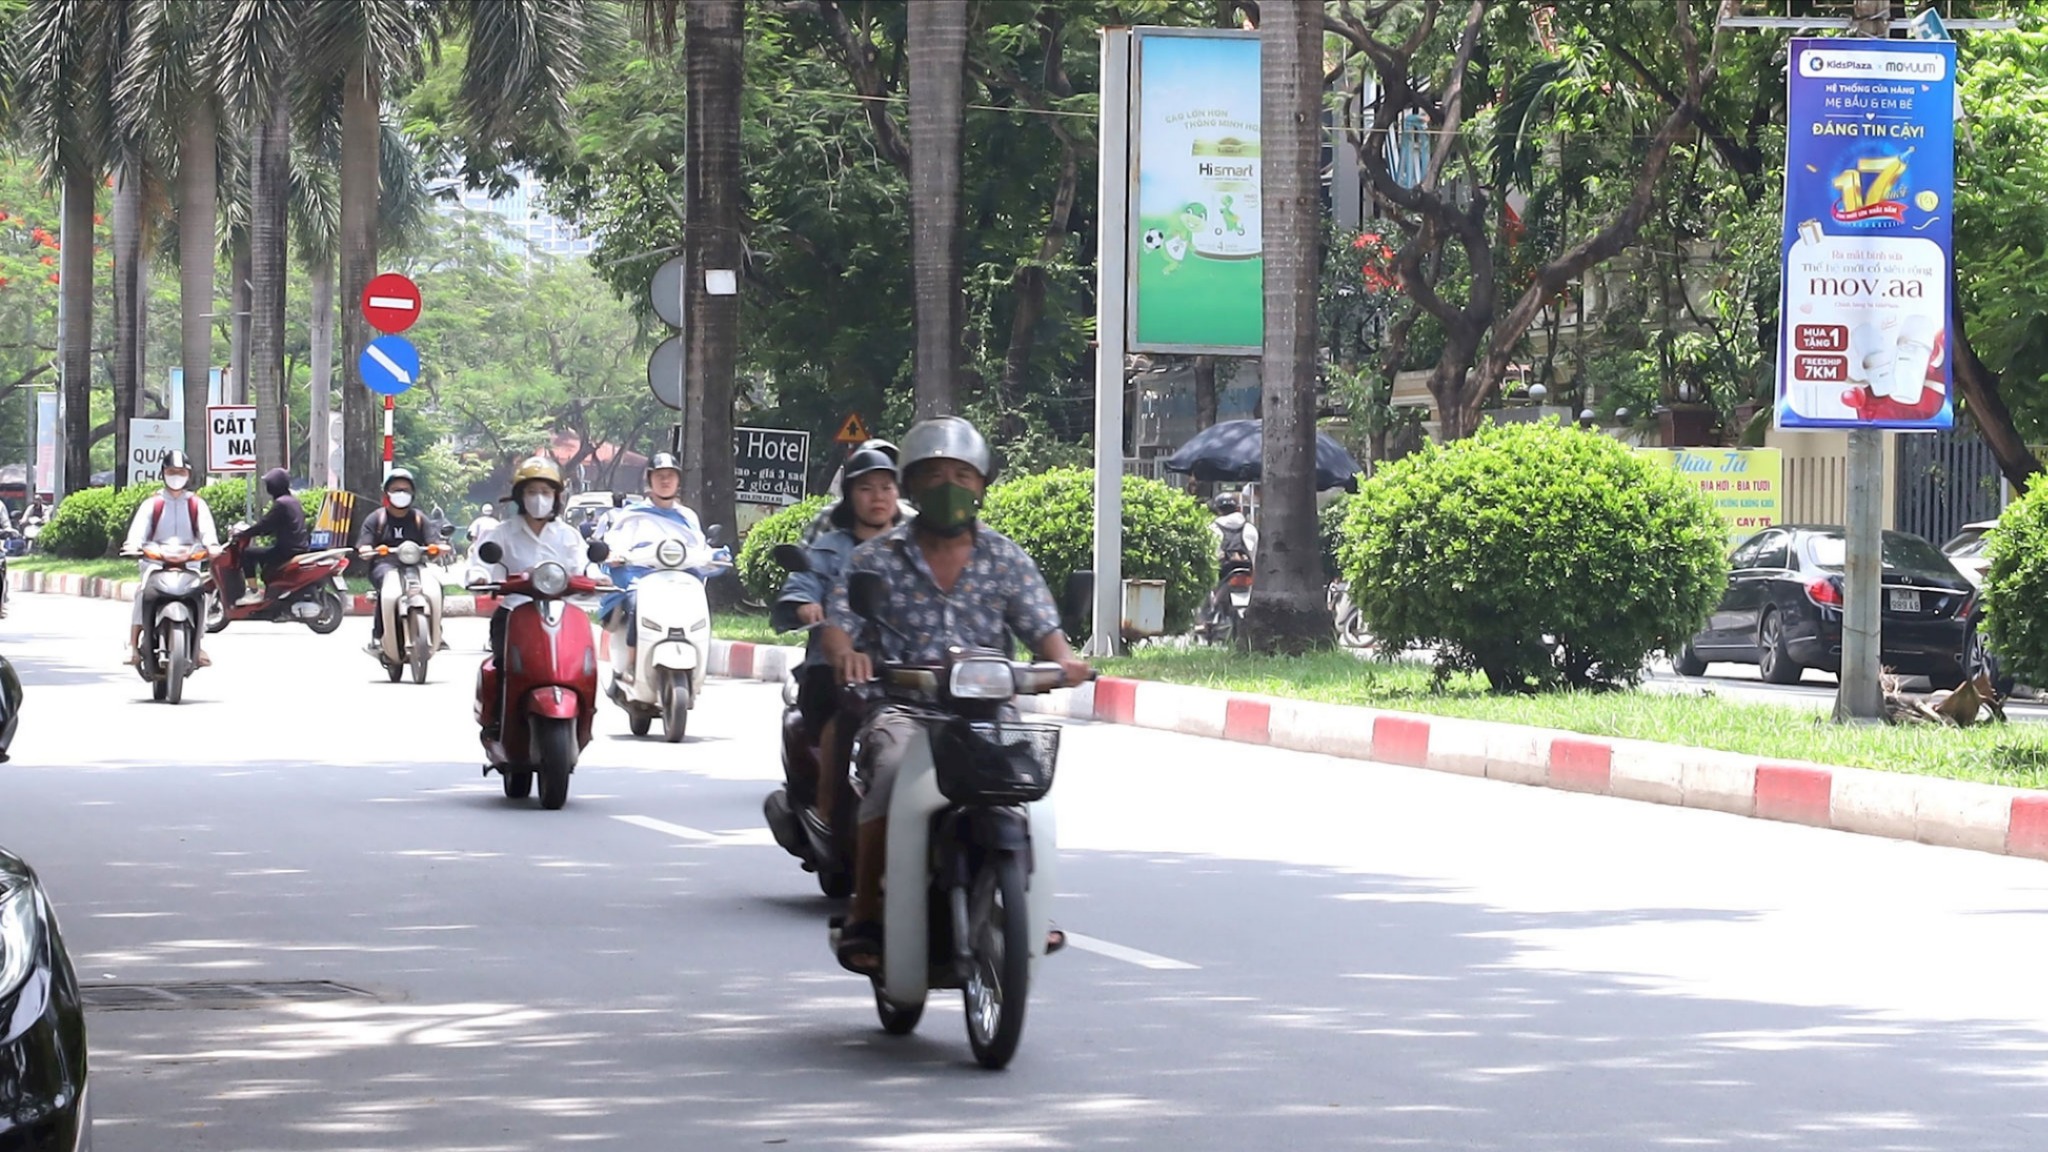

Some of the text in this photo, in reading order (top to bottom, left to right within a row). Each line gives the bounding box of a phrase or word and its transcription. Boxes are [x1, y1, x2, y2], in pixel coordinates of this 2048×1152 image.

[1826, 60, 1872, 70] KidsPlaza
[1825, 98, 1842, 109] MẸ
[1870, 98, 1880, 108] &
[1881, 100, 1897, 108] EM
[1900, 98, 1913, 110] BÉ
[1812, 120, 1858, 136] ĐÁNG
[1862, 124, 1886, 136] TIN
[1833, 156, 1907, 213] 17
[1810, 277, 1923, 298] mov.aa
[1804, 328, 1839, 348] MUA 1
[1802, 358, 1842, 366] FREESHIP
[1804, 366, 1836, 379] 7KM
[214, 412, 246, 434] CẮT
[748, 432, 805, 462] Hotel
[134, 446, 167, 464] QUÁ
[778, 470, 785, 479] 3
[788, 471, 804, 482] sao
[736, 478, 744, 490] 2
[1700, 480, 1714, 491] BIA
[1736, 480, 1750, 492] BIA
[1736, 518, 1756, 527] CAY
